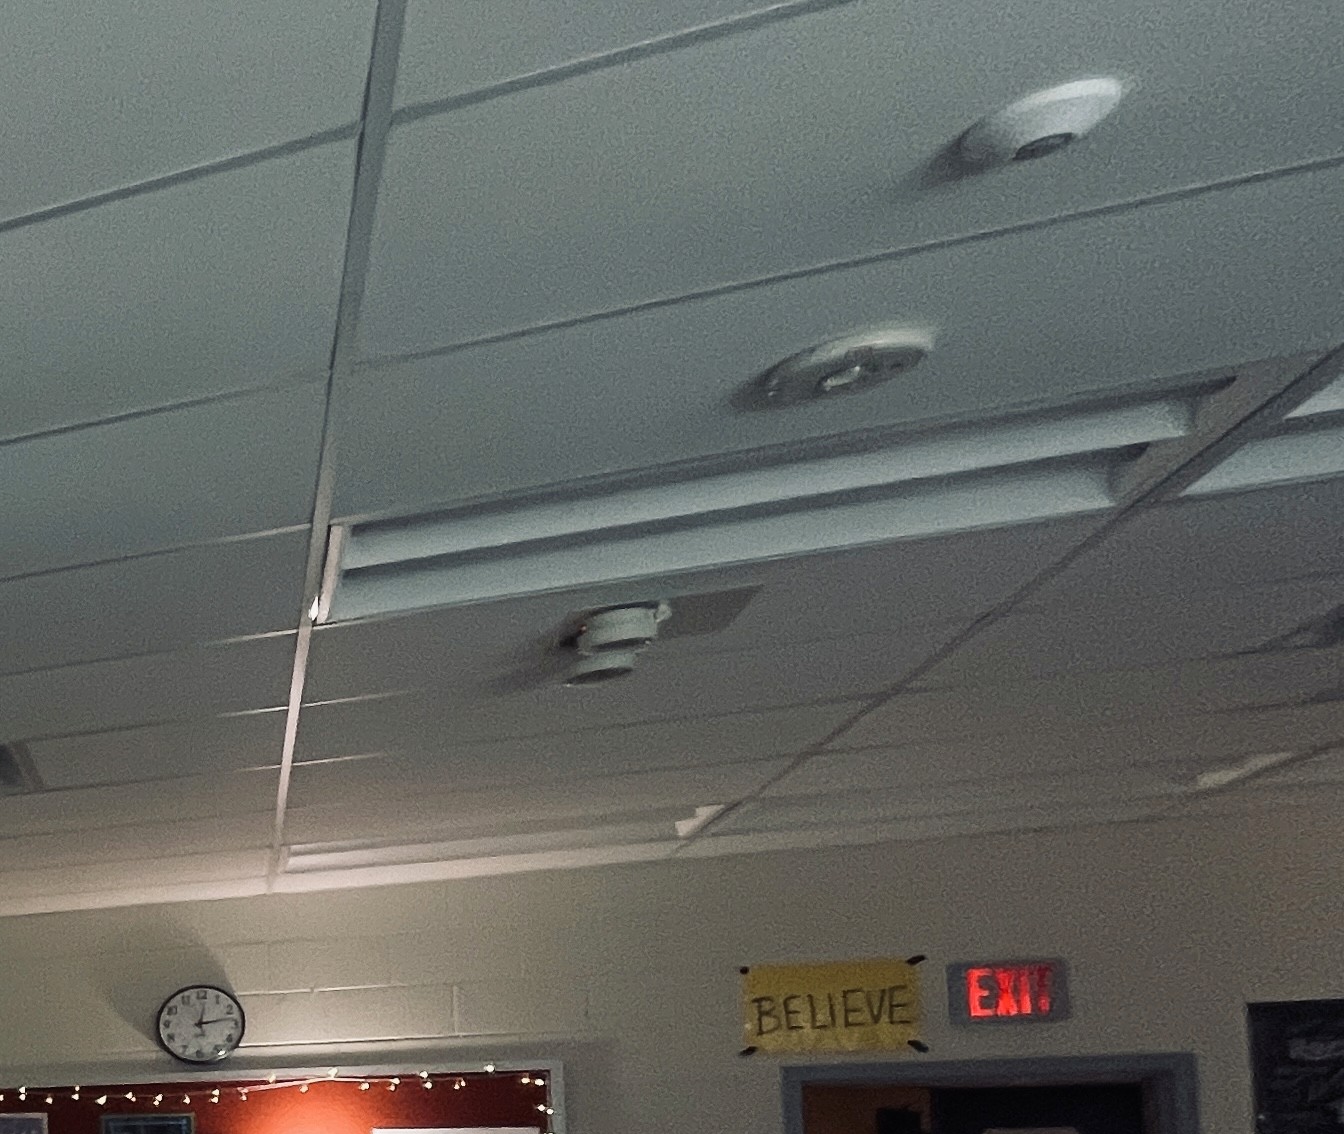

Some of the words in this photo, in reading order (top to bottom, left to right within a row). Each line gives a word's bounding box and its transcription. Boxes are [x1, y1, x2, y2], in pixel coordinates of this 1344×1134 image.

[196, 989, 208, 1000] 12
[965, 966, 1051, 1018] EXIT
[226, 1003, 234, 1015] 2
[751, 984, 912, 1037] BELIEVE
